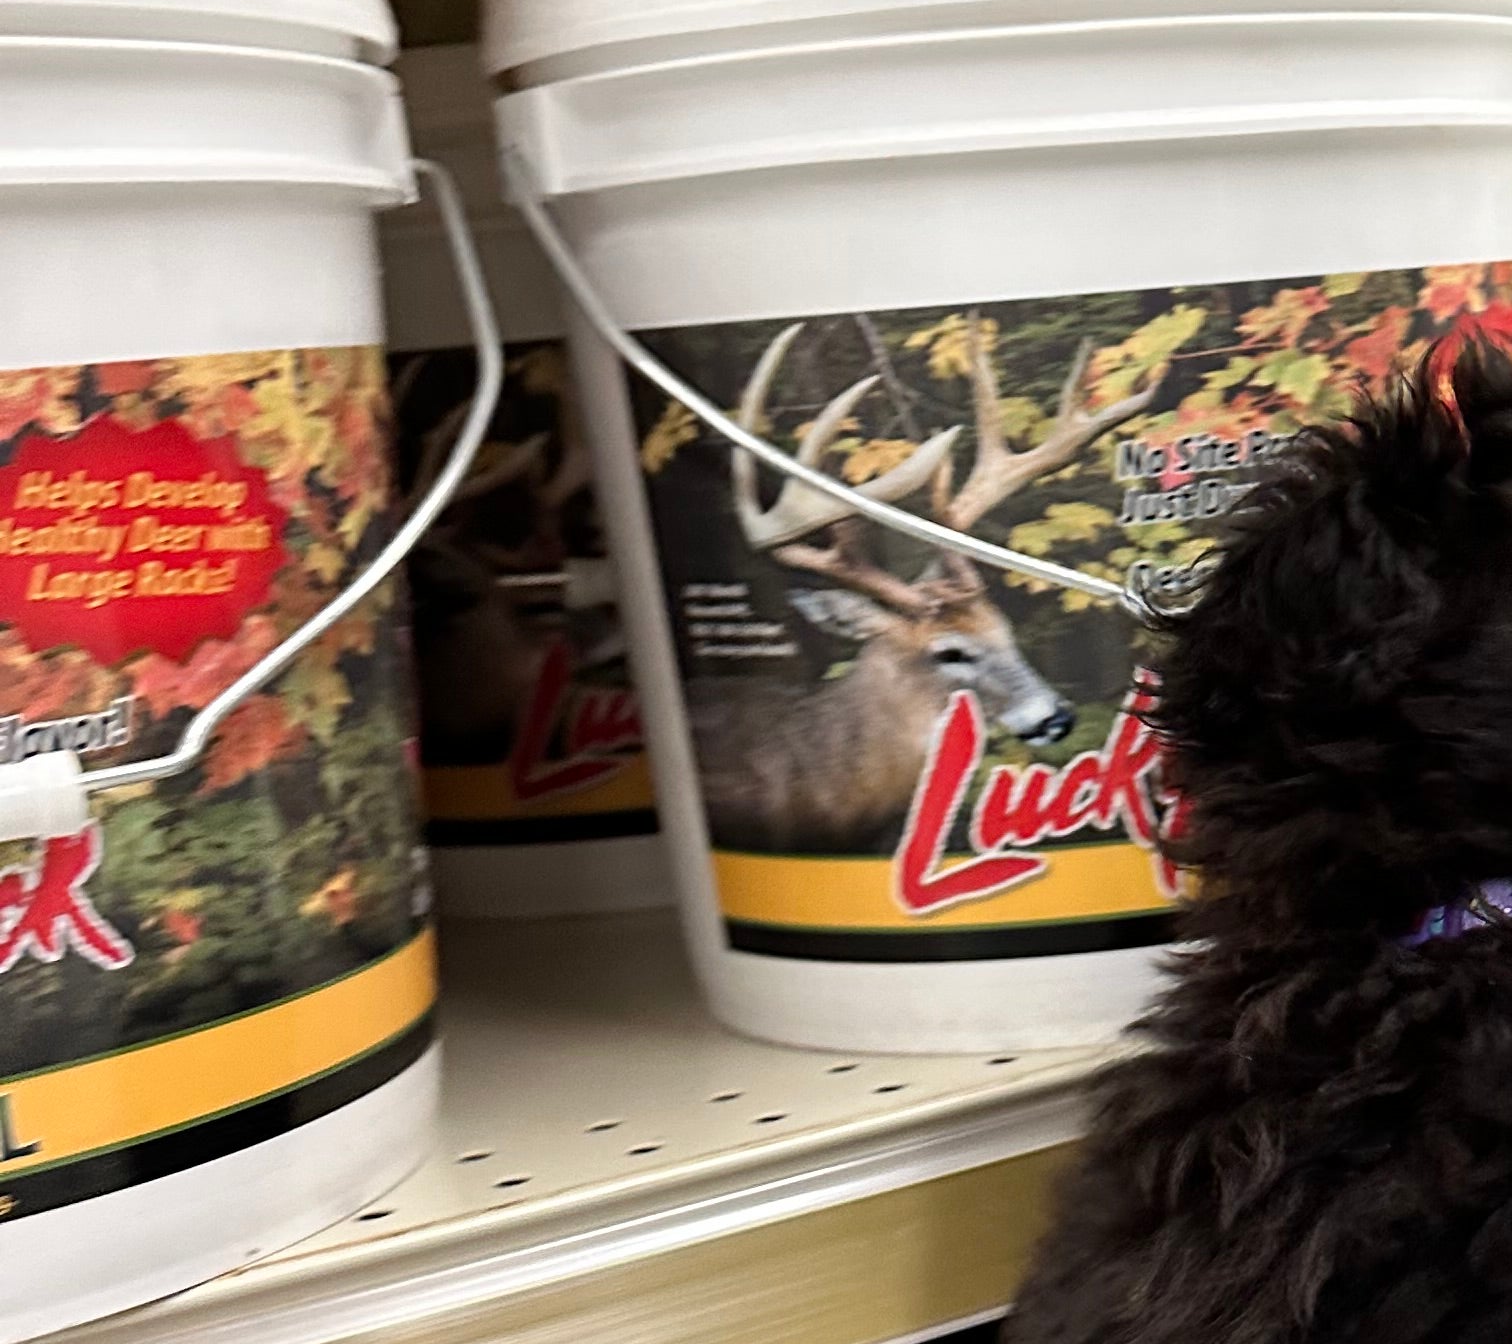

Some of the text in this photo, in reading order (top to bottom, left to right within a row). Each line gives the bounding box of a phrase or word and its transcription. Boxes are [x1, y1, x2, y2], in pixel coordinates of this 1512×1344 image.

[1116, 442, 1167, 482] No
[1175, 435, 1241, 473] Site
[13, 467, 248, 517] Helps Develop
[1118, 484, 1198, 527] Just
[123, 514, 206, 555] Deer
[25, 561, 135, 609] Large
